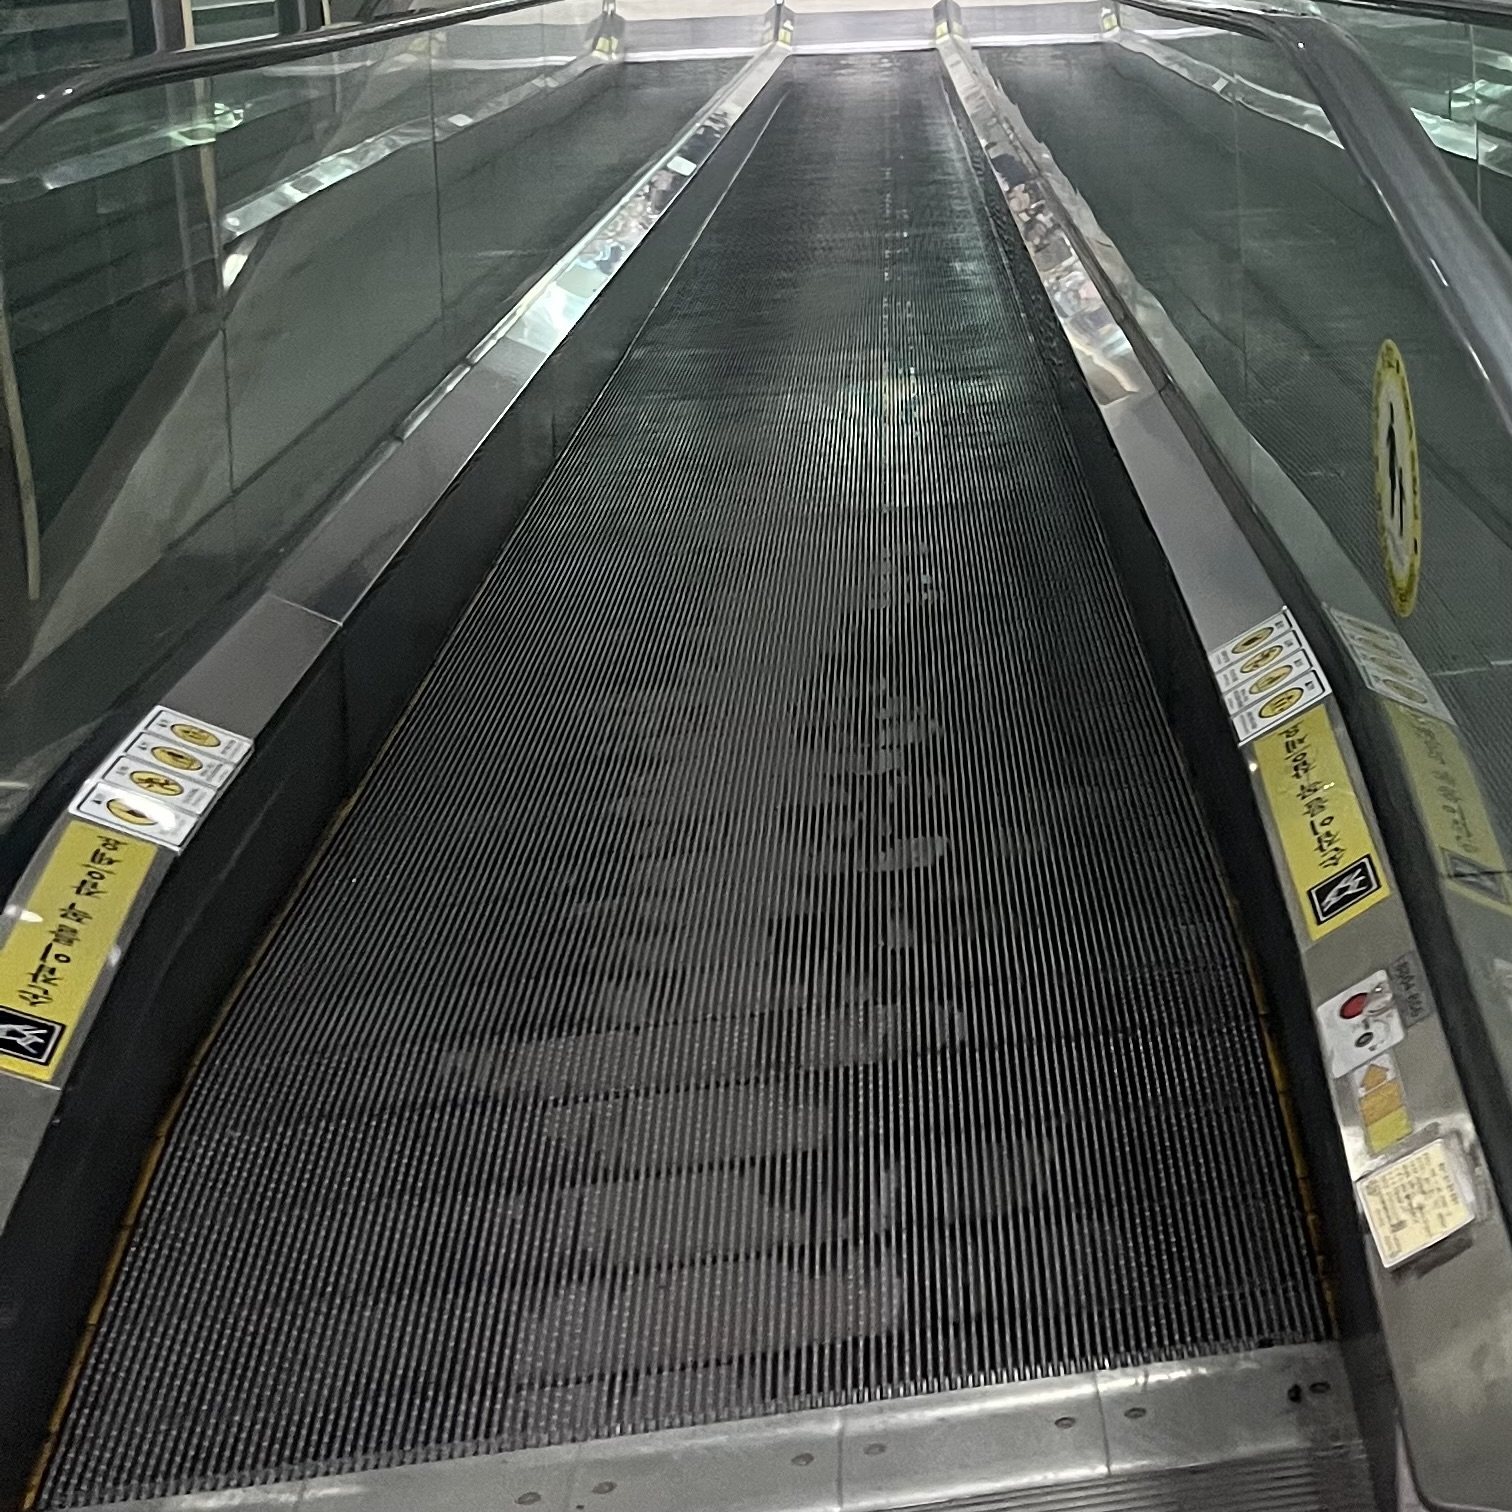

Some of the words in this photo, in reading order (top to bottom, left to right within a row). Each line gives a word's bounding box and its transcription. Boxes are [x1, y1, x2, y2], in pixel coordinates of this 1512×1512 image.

[1277, 719, 1317, 780] 잡으세요
[1301, 796, 1347, 869] 손잡이를
[70, 835, 128, 899] 잡으세요
[58, 901, 94, 925] 꼭
[17, 923, 81, 1007] 손잡이를
